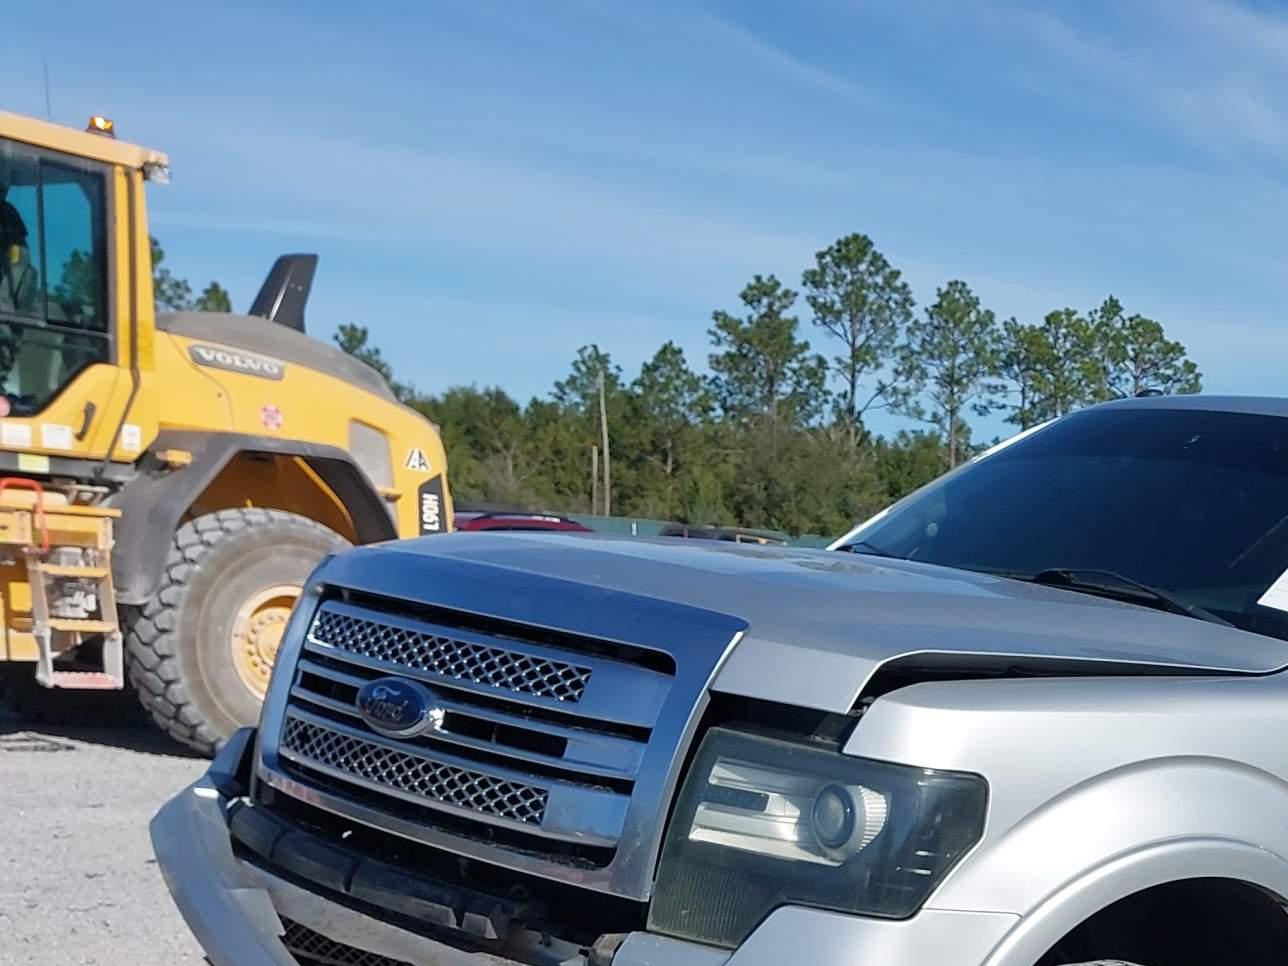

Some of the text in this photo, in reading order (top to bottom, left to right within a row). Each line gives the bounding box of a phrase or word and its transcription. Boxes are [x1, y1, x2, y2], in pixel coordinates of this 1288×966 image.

[193, 346, 280, 375] VOLVO
[422, 493, 440, 531] L90H
[366, 684, 409, 721] Ford
